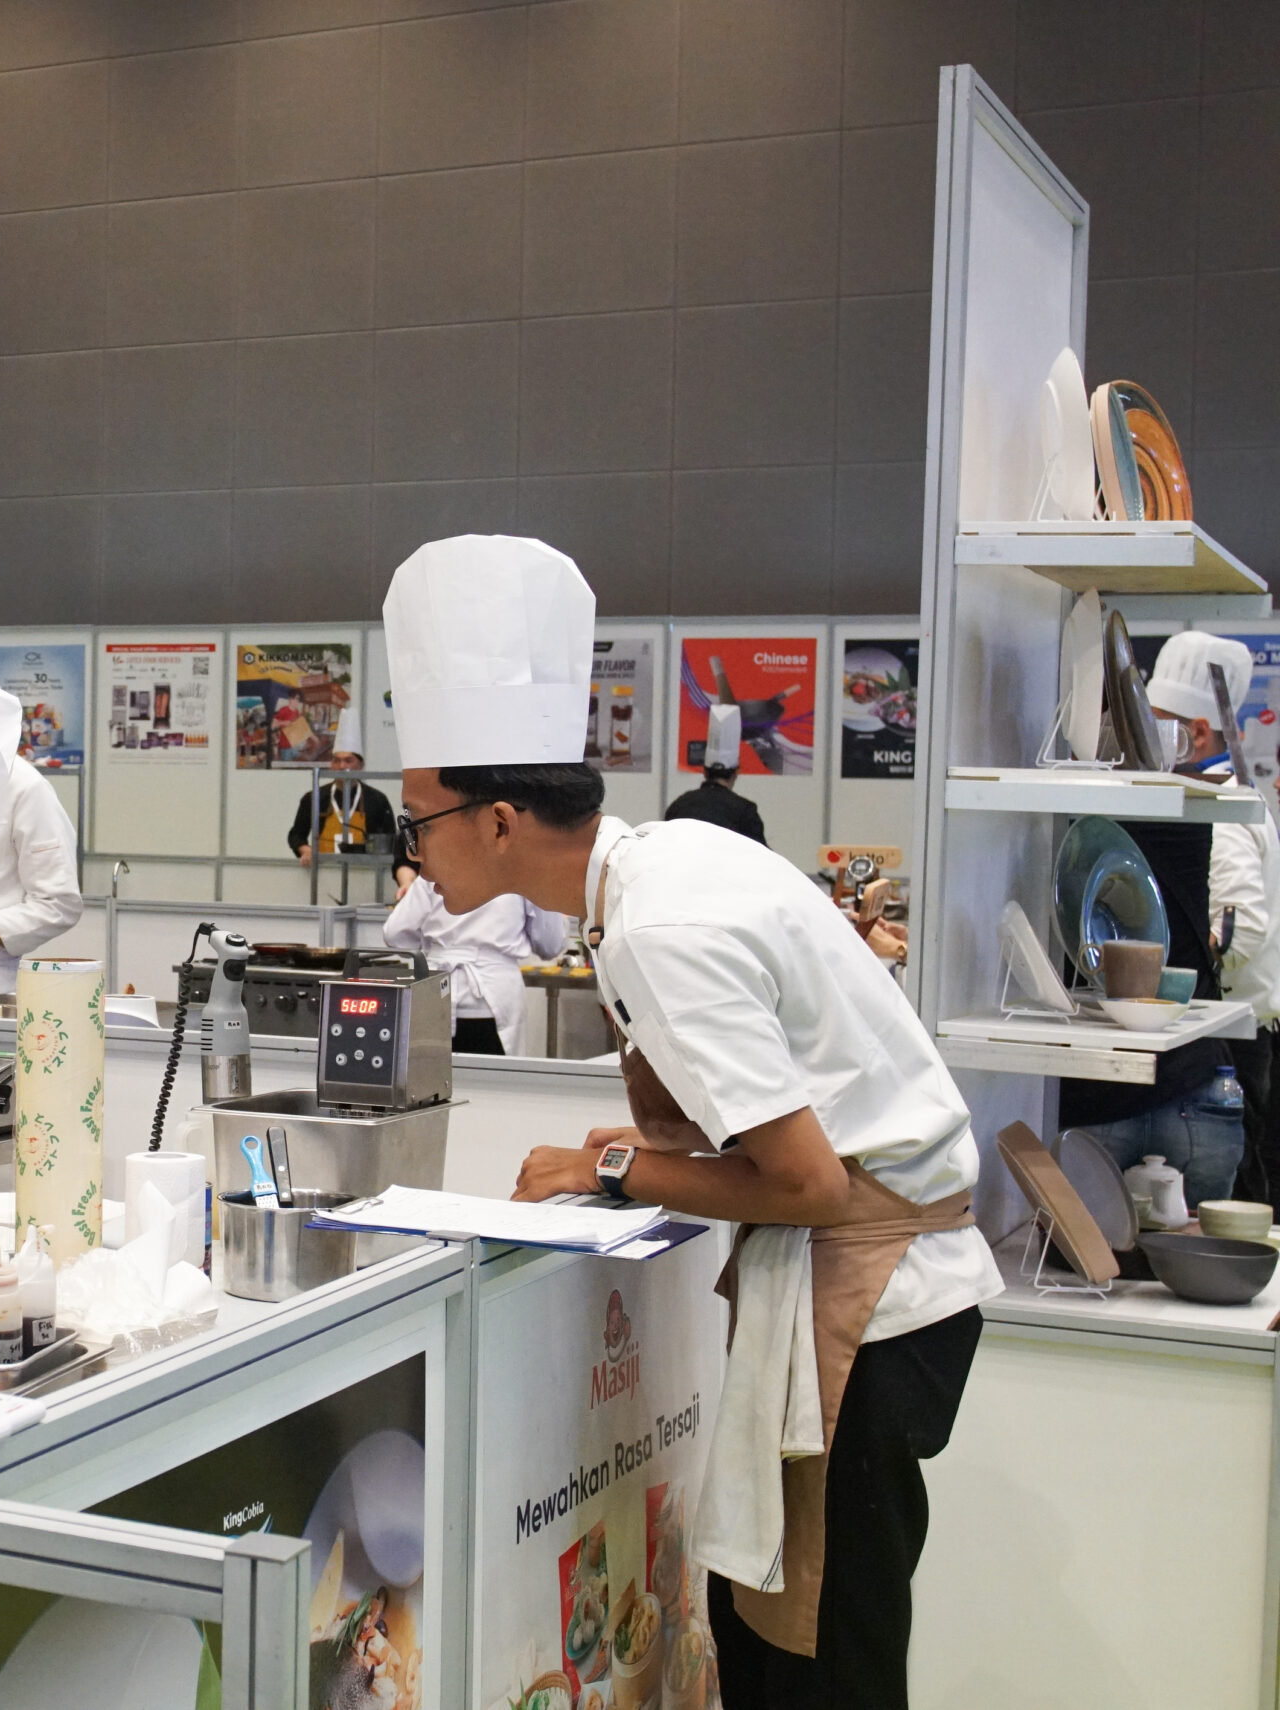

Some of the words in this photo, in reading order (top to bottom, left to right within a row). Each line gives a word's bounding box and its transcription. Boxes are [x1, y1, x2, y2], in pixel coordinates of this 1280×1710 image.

[258, 653, 314, 662] KIKKOMAN
[753, 652, 808, 665] Chinese
[34, 673, 47, 683] 30
[873, 750, 912, 763] KING
[72, 1180, 97, 1216] Fresh
[74, 1220, 95, 1246] Best
[590, 1341, 640, 1410] Masiji
[516, 1460, 609, 1545] Mewahkan
[615, 1432, 653, 1480] Rasa
[656, 1392, 700, 1451] Tersaji
[223, 1501, 265, 1532] KingCobia
